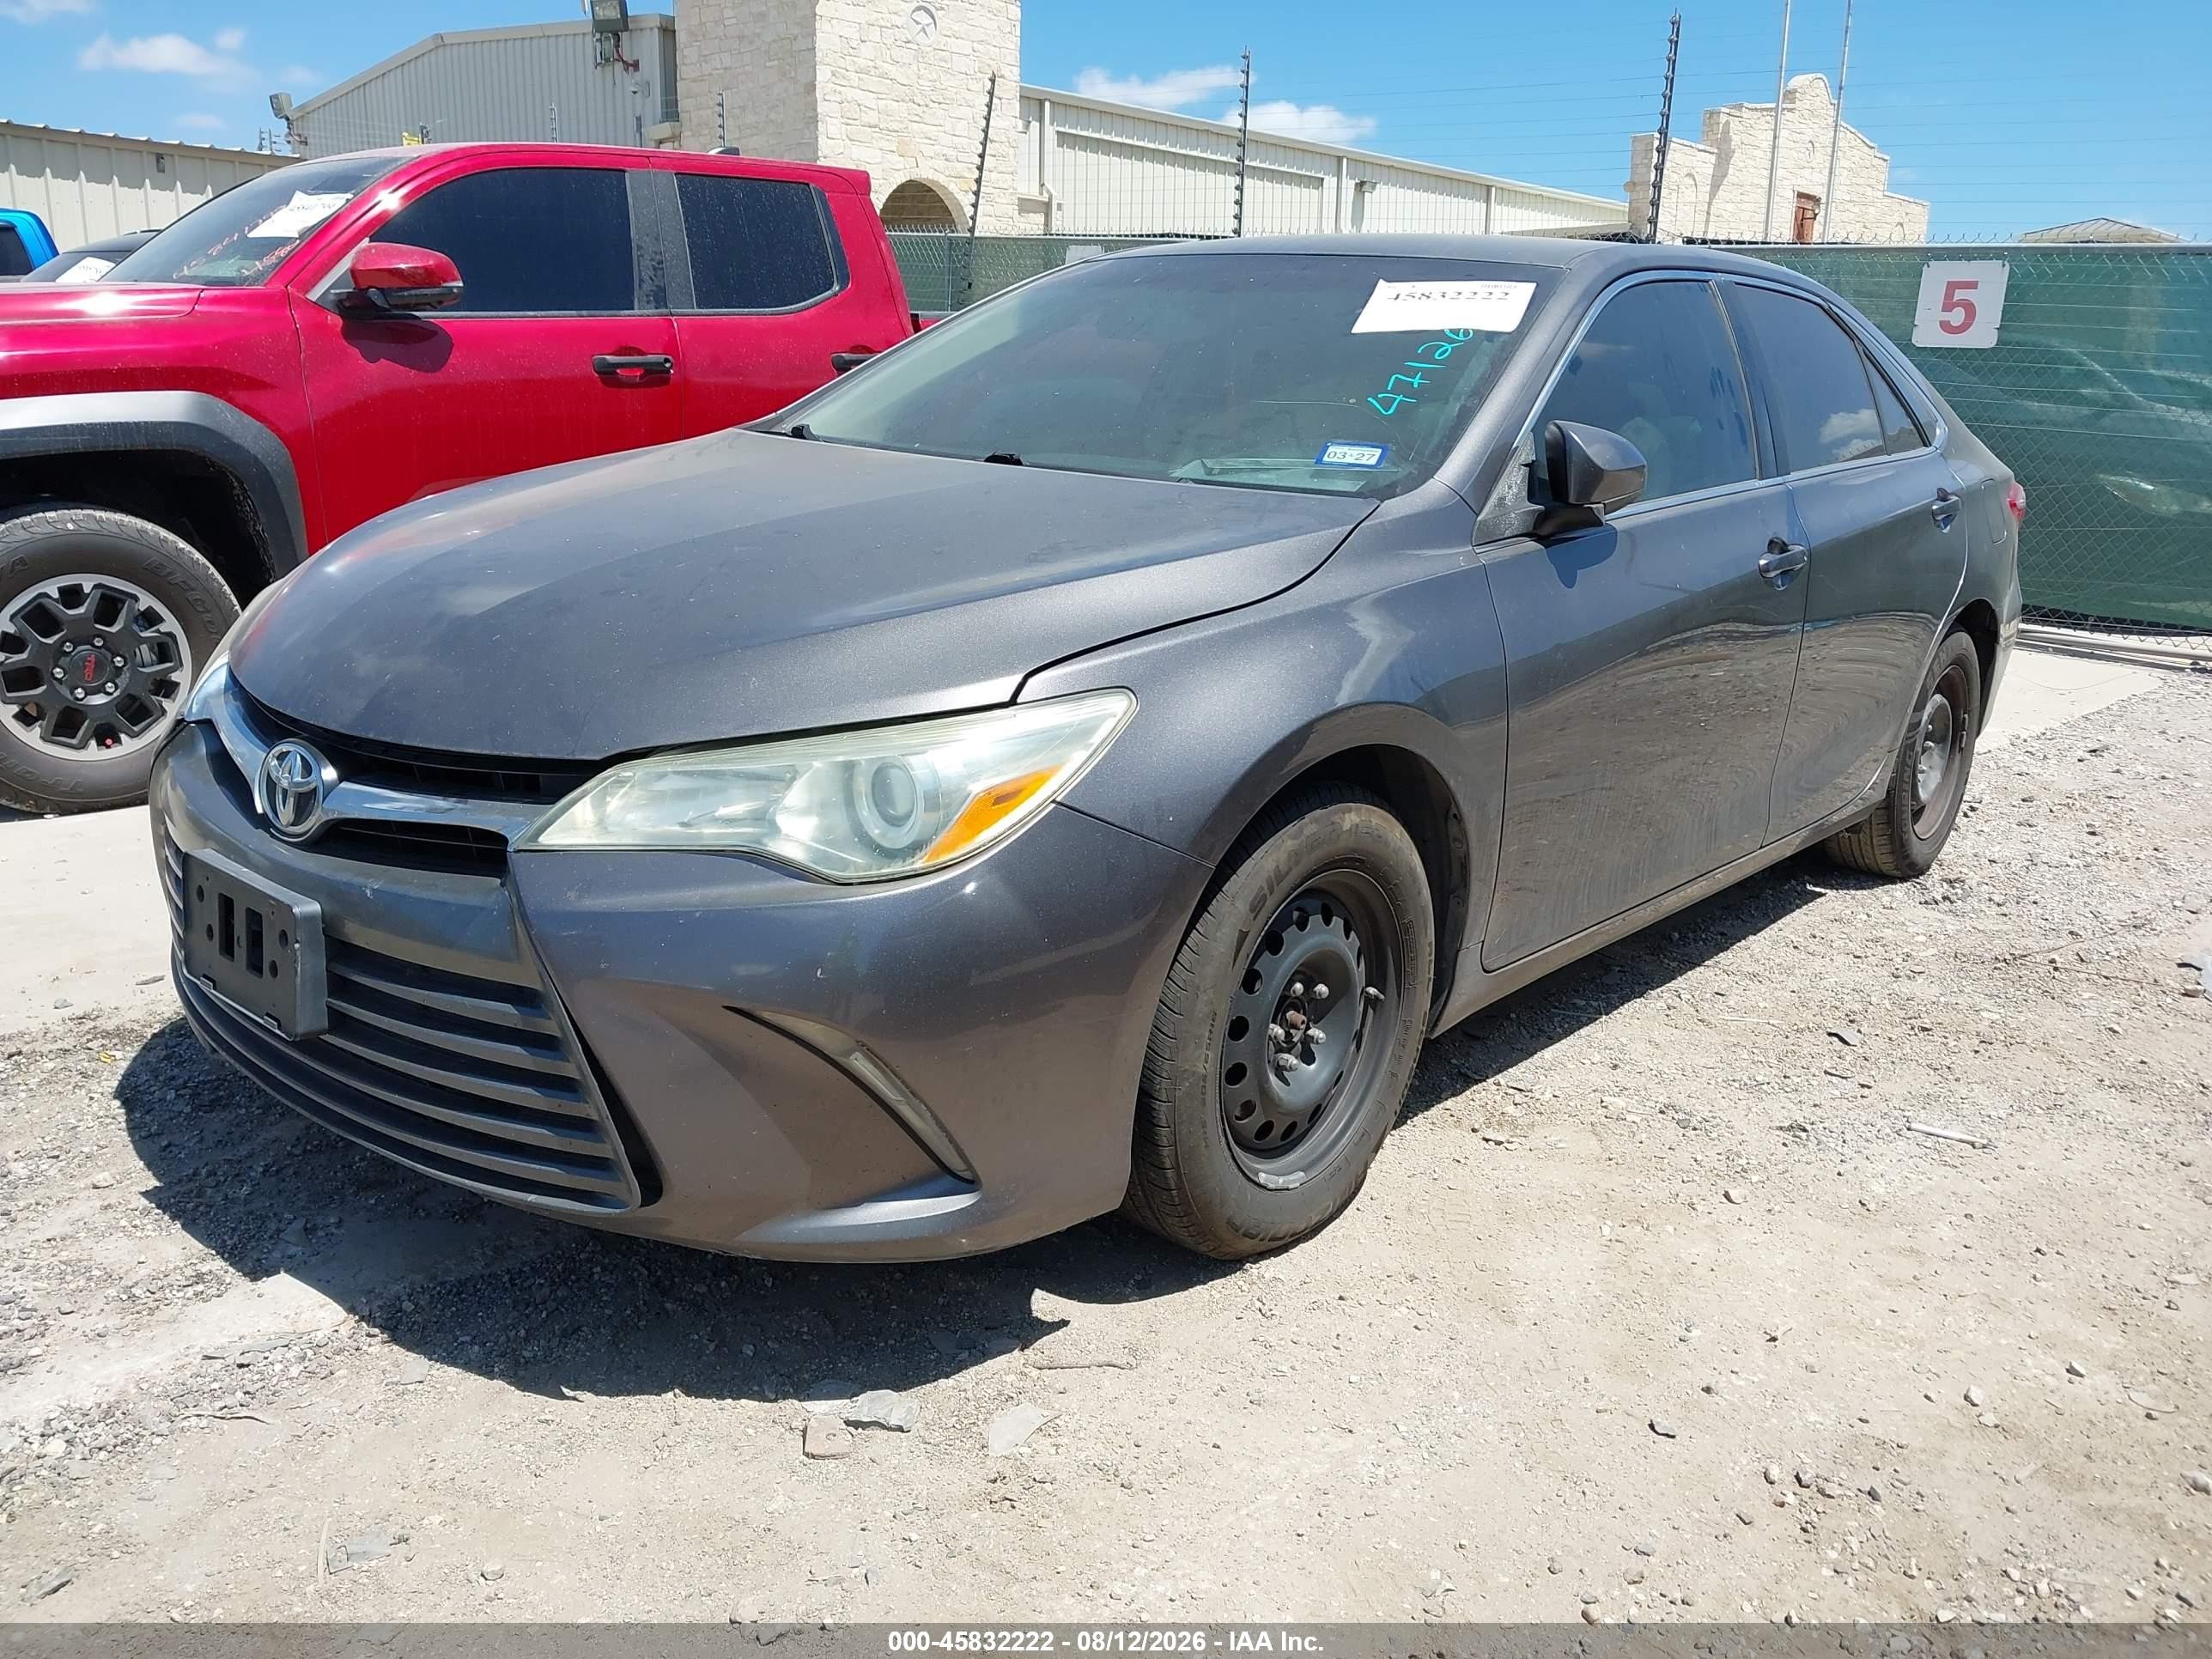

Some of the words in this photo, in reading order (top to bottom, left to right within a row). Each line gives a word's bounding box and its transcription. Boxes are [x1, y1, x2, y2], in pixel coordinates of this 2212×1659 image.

[1938, 280, 1979, 335] 5
[1327, 451, 1347, 460] 03
[1354, 453, 1376, 461] 27
